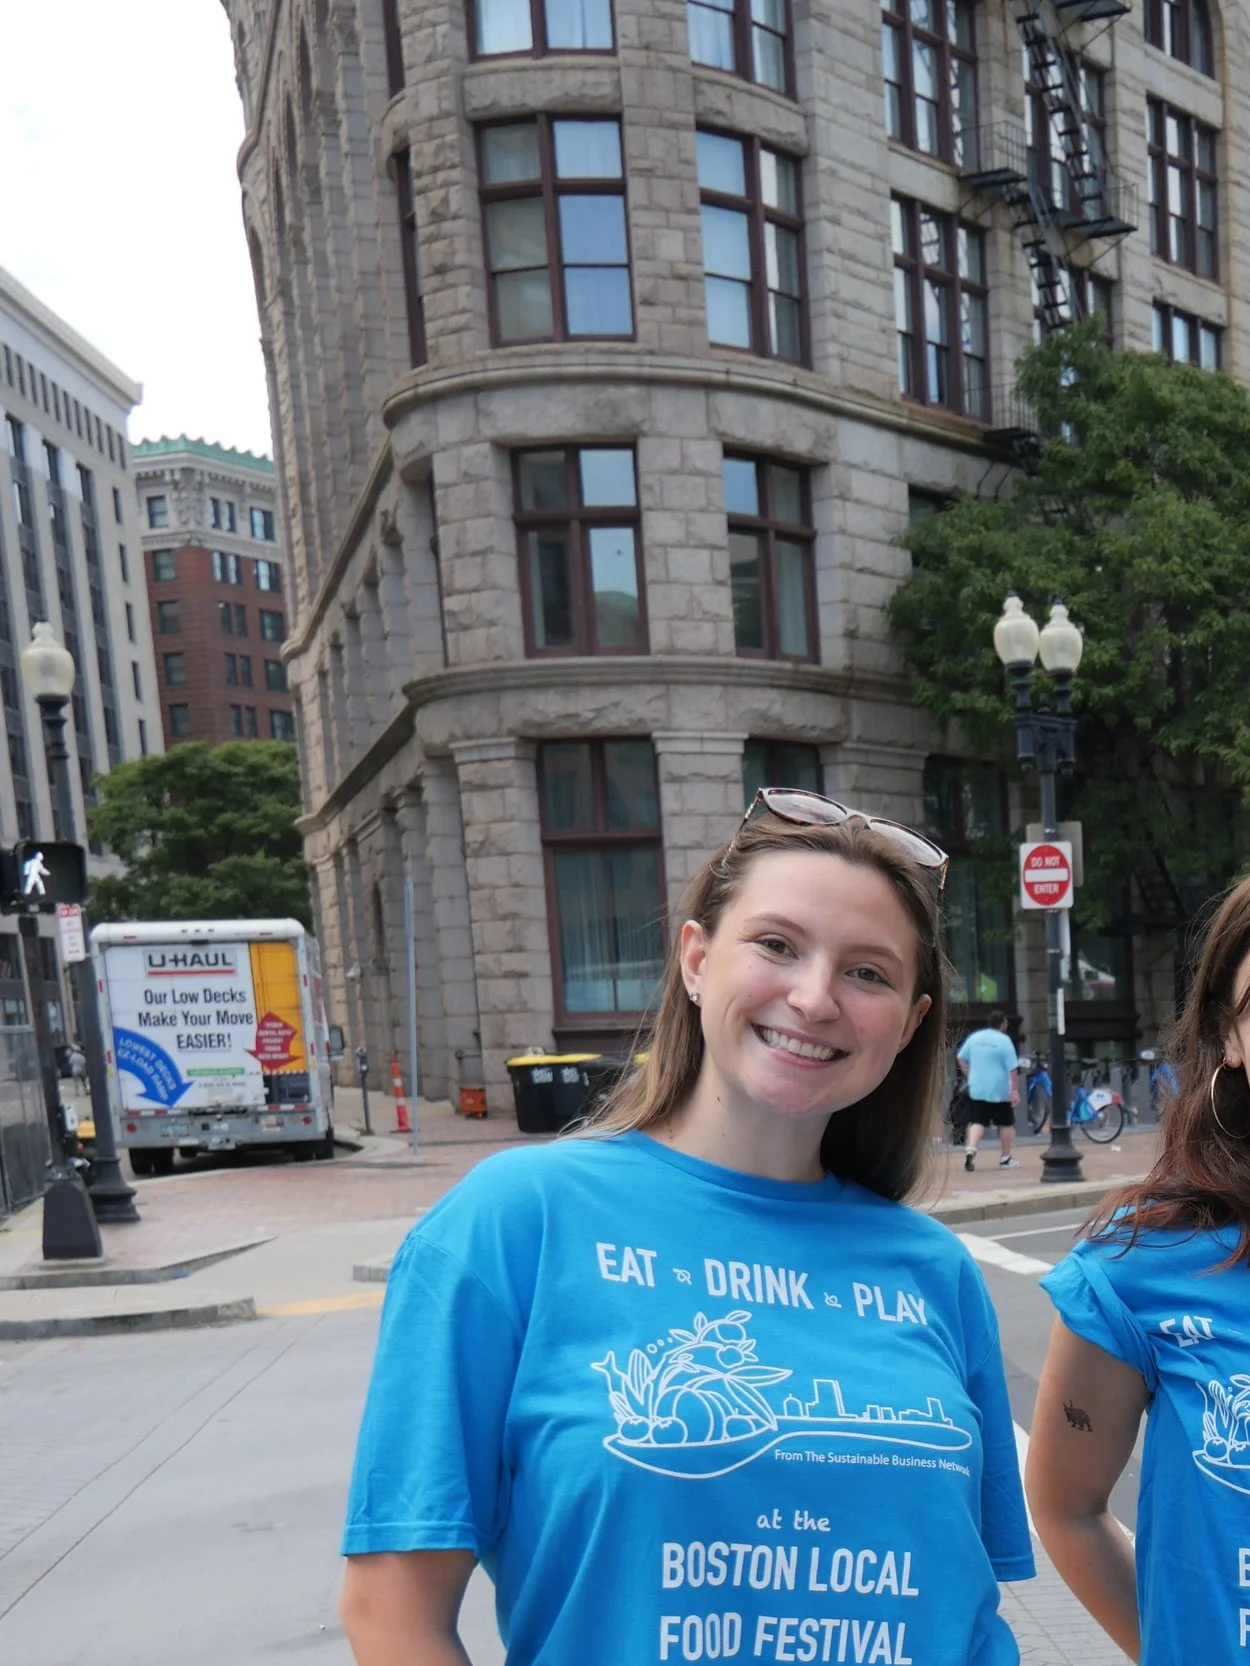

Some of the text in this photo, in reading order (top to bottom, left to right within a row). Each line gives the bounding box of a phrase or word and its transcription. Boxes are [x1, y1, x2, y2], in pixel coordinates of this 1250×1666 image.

[1031, 856, 1060, 868] DO NOT
[1034, 883, 1060, 895] ENTER
[148, 951, 233, 968] U-HAUL
[144, 988, 246, 1004] Our Low Decks
[138, 1010, 253, 1027] Make Your Move
[177, 1033, 232, 1050] EASIER!
[596, 1242, 657, 1288] EAT
[704, 1258, 815, 1310] DRINK
[852, 1281, 928, 1326] PLAY
[1159, 1315, 1216, 1348] EAT
[775, 1449, 803, 1461] From
[805, 1451, 825, 1463] The
[828, 1452, 890, 1465] Sustainable
[892, 1455, 937, 1469] Business
[757, 1509, 831, 1532] at the
[661, 1541, 919, 1597] BOSTON LOCAL
[659, 1611, 913, 1666] FOOD FESTIVAL
